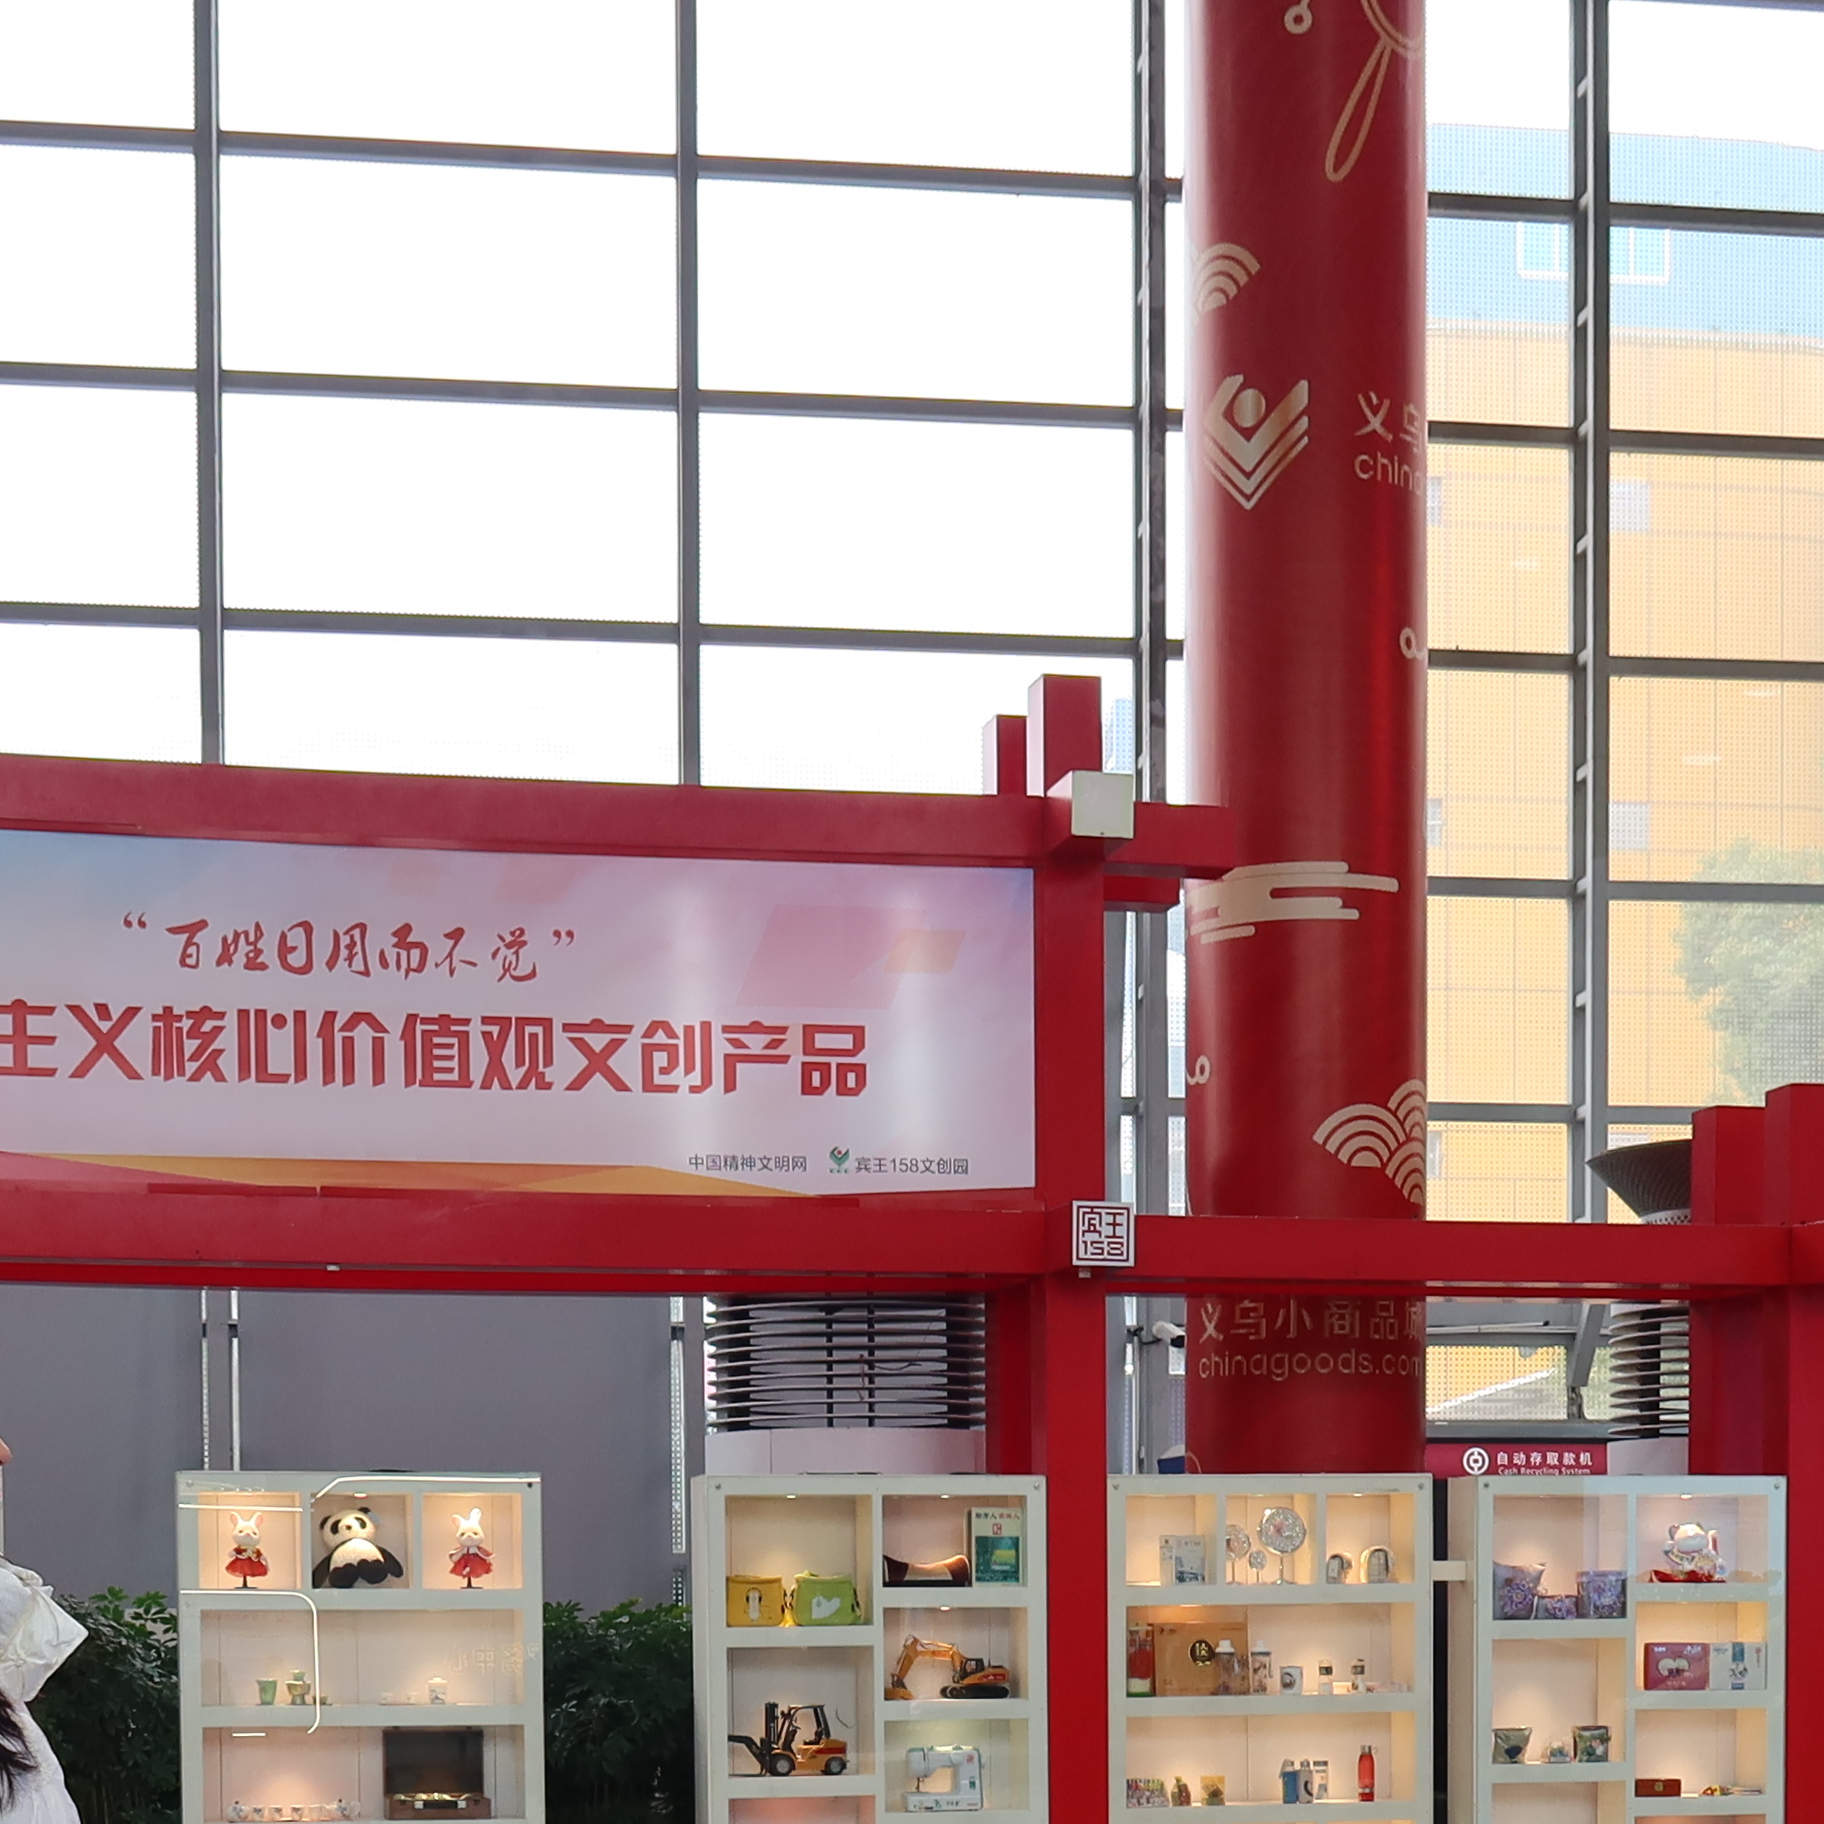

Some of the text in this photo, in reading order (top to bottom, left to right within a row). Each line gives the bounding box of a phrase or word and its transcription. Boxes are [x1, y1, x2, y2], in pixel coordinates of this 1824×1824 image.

[688, 1153, 969, 1175] 中国精神文明网 宾王158文创园
[1497, 1451, 1592, 1465] 自动存取款机
